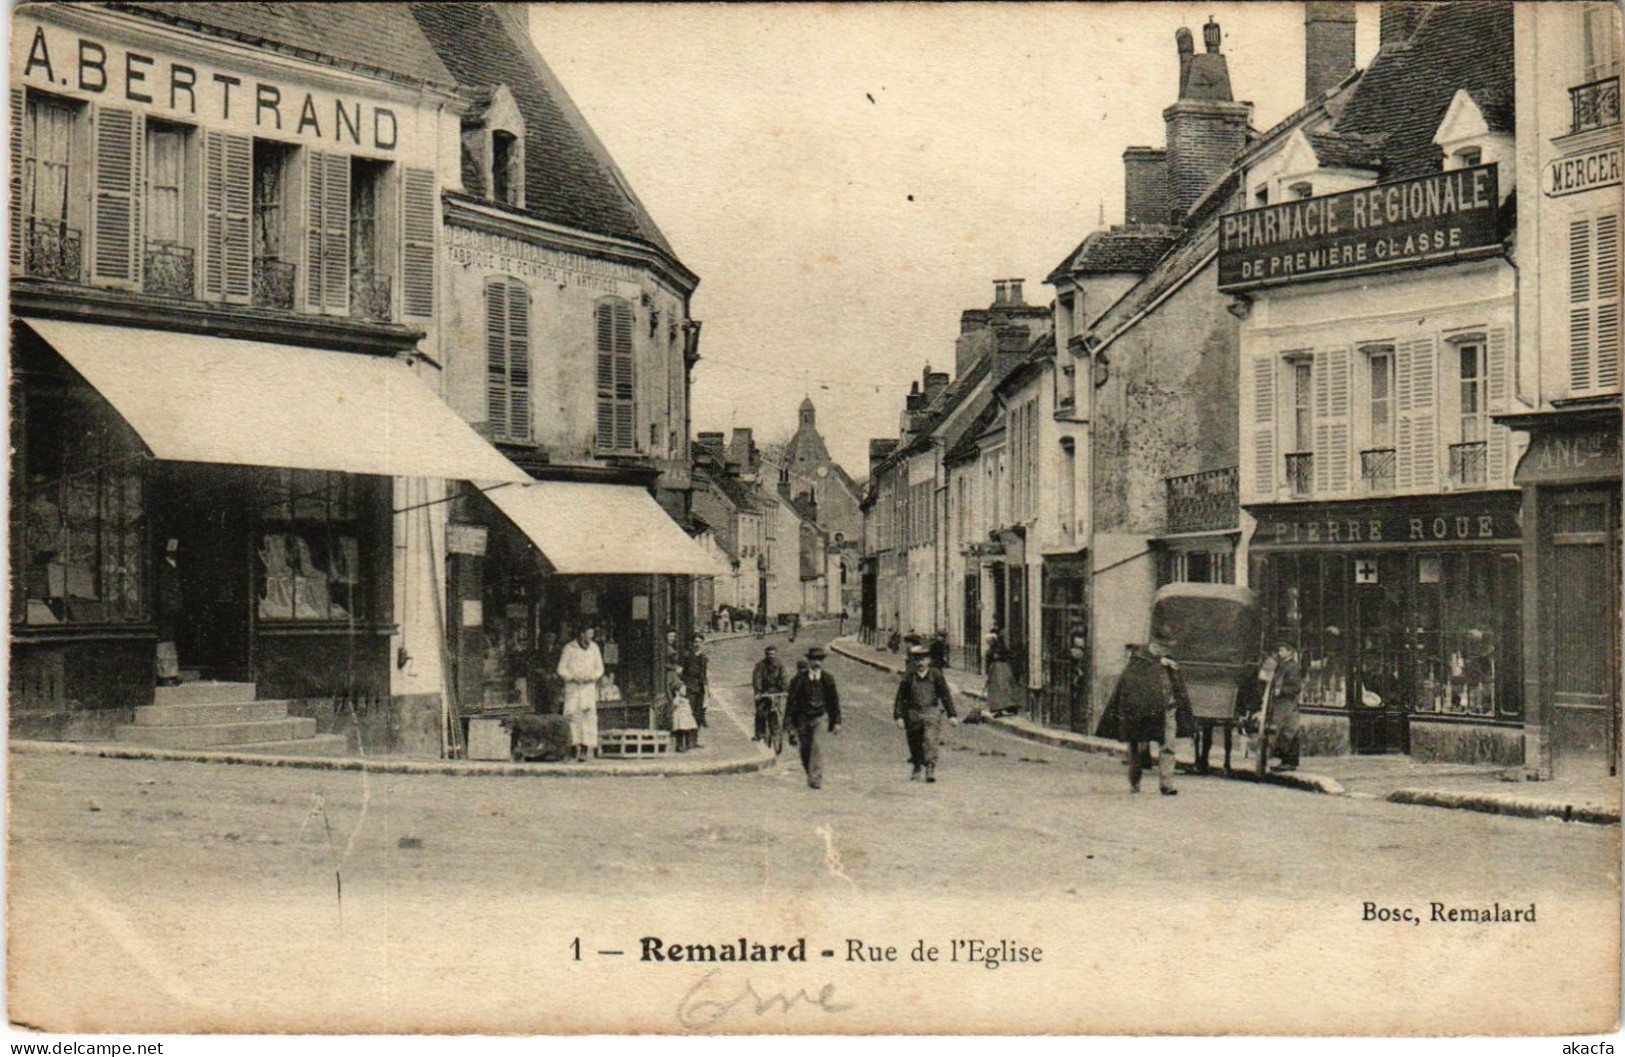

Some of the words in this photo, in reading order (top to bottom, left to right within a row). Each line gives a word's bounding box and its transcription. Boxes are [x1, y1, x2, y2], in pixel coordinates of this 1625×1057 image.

[1224, 199, 1339, 250] PHARMACIE
[1242, 260, 1264, 279] DE
[1375, 227, 1461, 258] CLASSE
[1275, 520, 1382, 543] PIERRE
